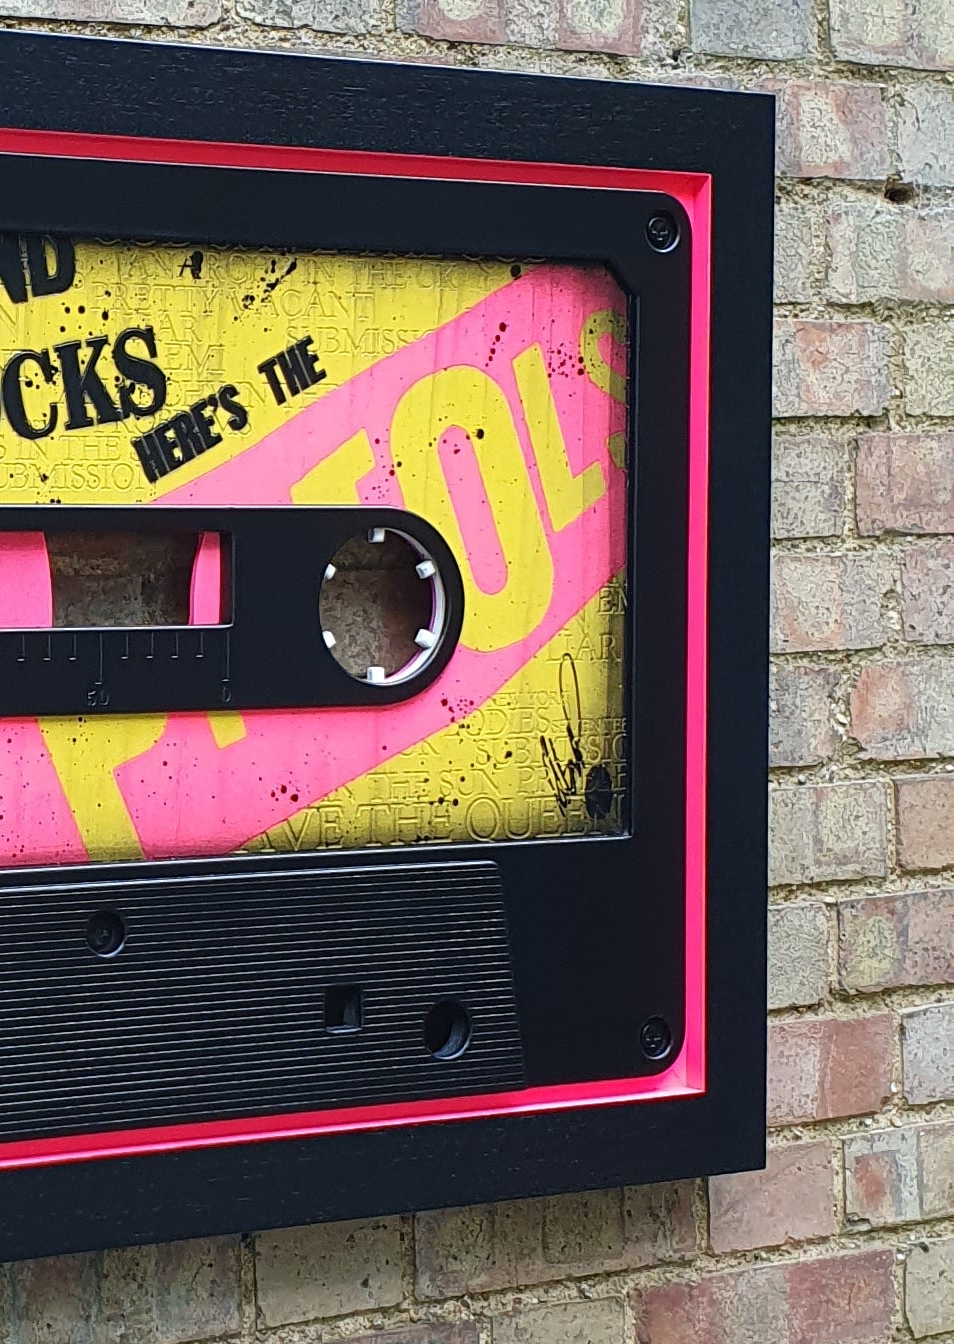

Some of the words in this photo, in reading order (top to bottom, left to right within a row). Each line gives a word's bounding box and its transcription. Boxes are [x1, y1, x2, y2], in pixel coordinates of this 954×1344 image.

[90, 281, 219, 315] PRETTY
[130, 384, 248, 485] HERE'S
[257, 336, 327, 406] THE
[86, 689, 111, 708] 50
[220, 684, 233, 705] 0
[358, 799, 452, 847] THE
